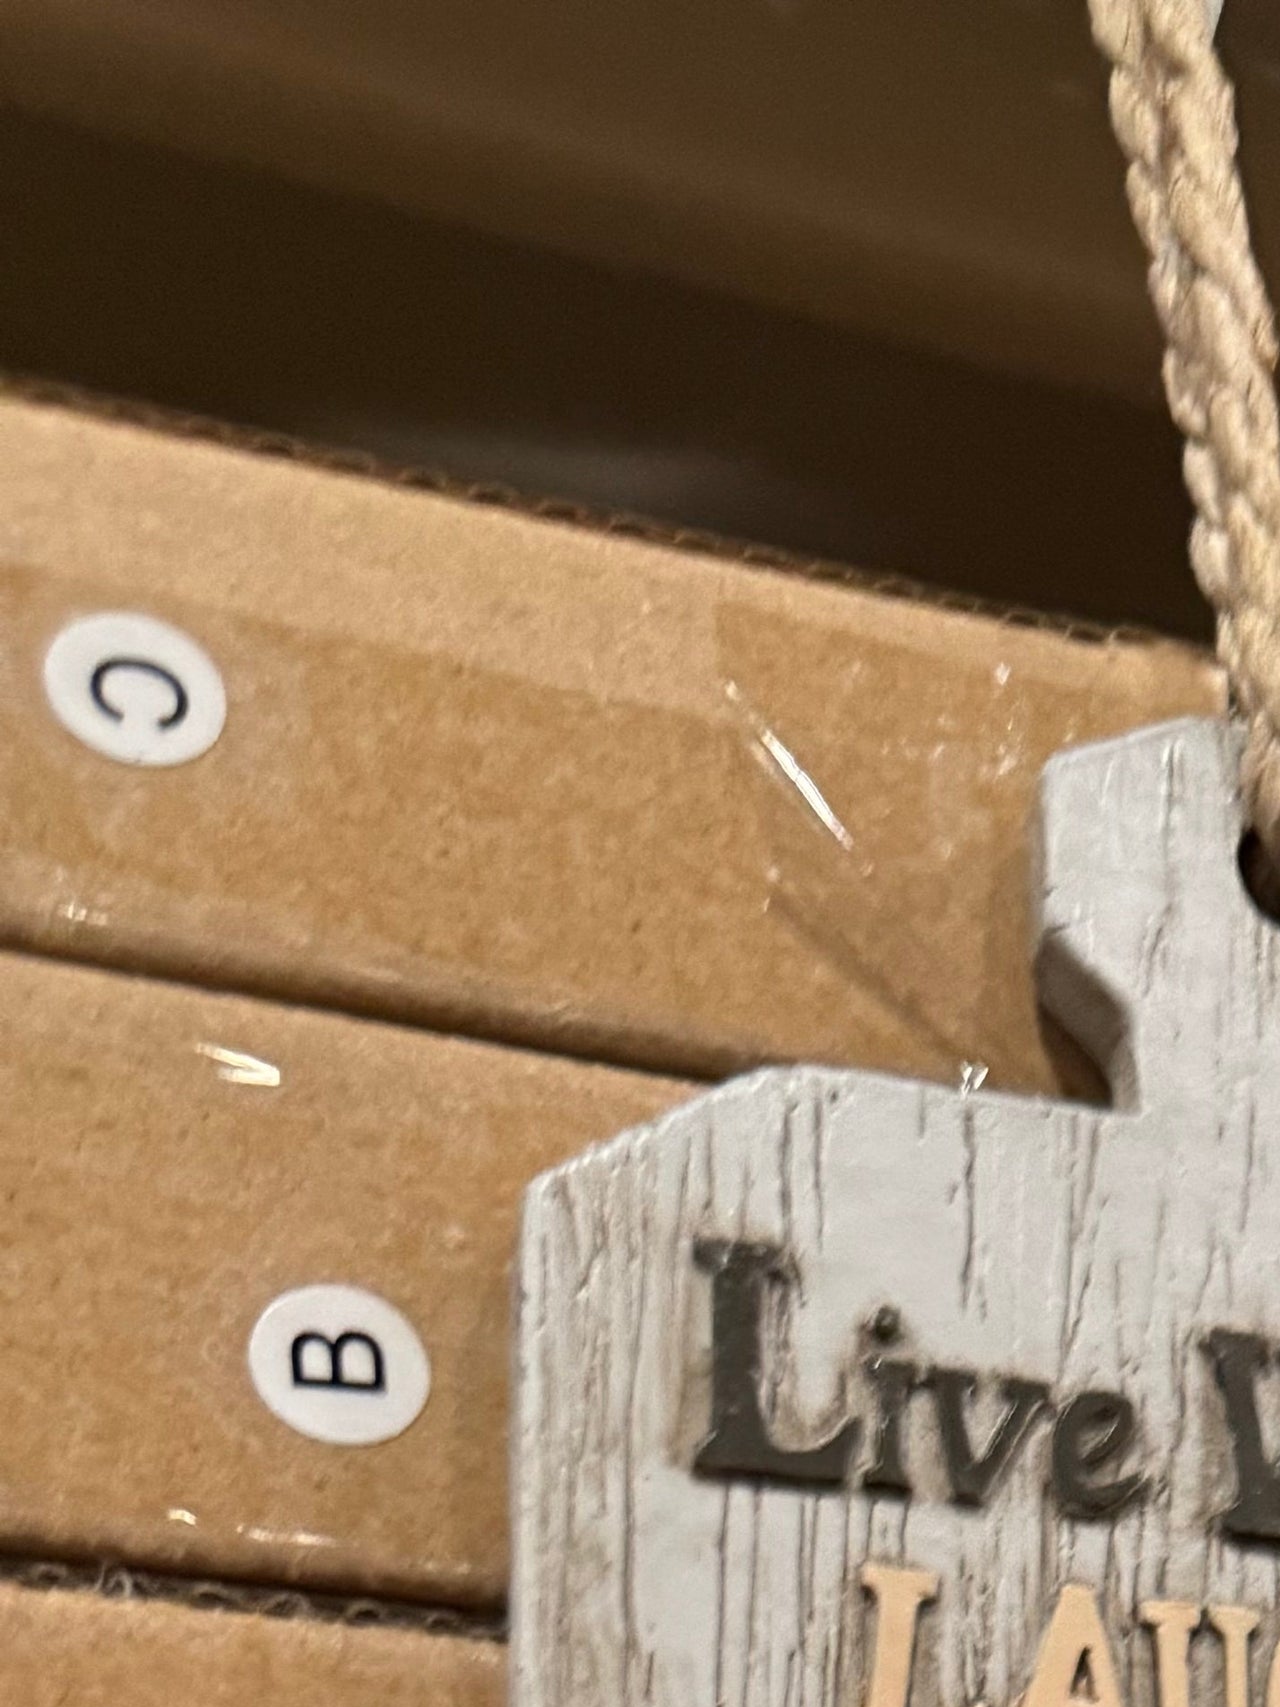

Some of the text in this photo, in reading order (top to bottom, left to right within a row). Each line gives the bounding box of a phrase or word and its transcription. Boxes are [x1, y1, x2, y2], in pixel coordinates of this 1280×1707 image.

[90, 656, 189, 733] C
[291, 1329, 388, 1392] B
[692, 1236, 1150, 1522] Live
